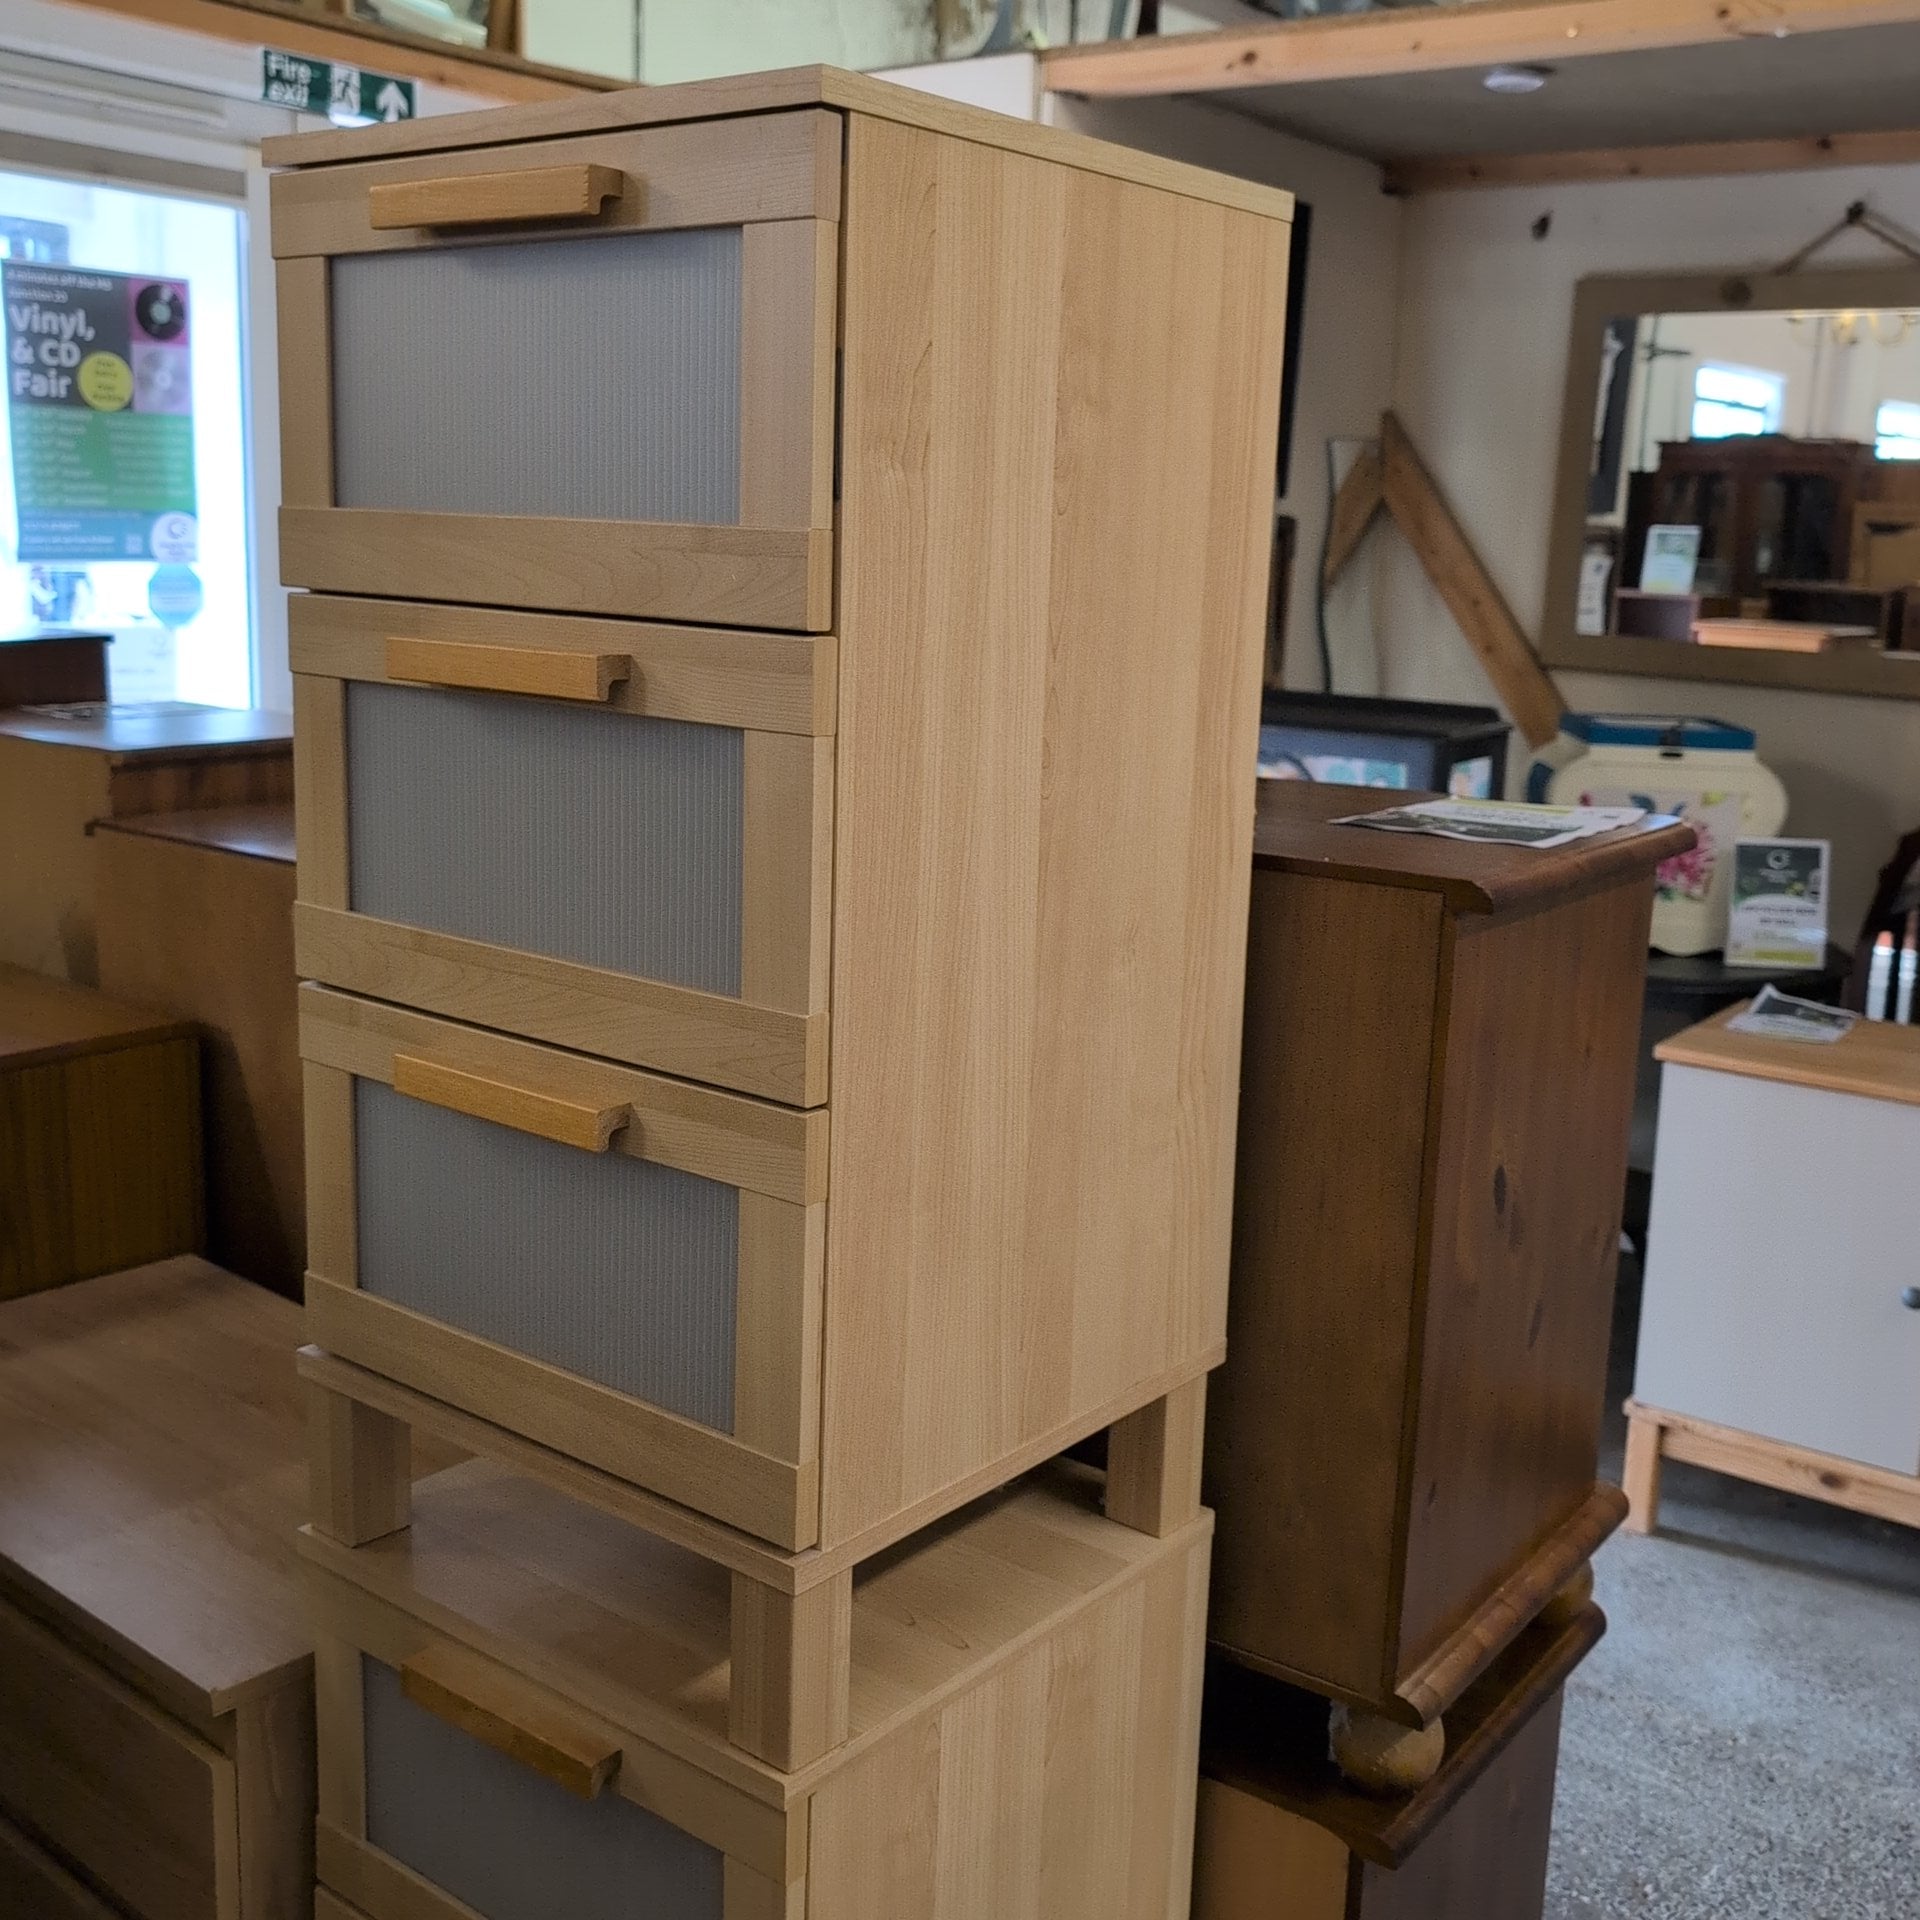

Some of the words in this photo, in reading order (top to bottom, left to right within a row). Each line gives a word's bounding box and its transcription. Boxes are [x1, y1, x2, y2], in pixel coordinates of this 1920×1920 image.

[267, 53, 312, 86] Fire
[267, 80, 310, 108] exit
[9, 302, 96, 342] Vinyl,
[11, 336, 35, 365] &
[38, 337, 82, 368] CD
[13, 367, 73, 399] Fair
